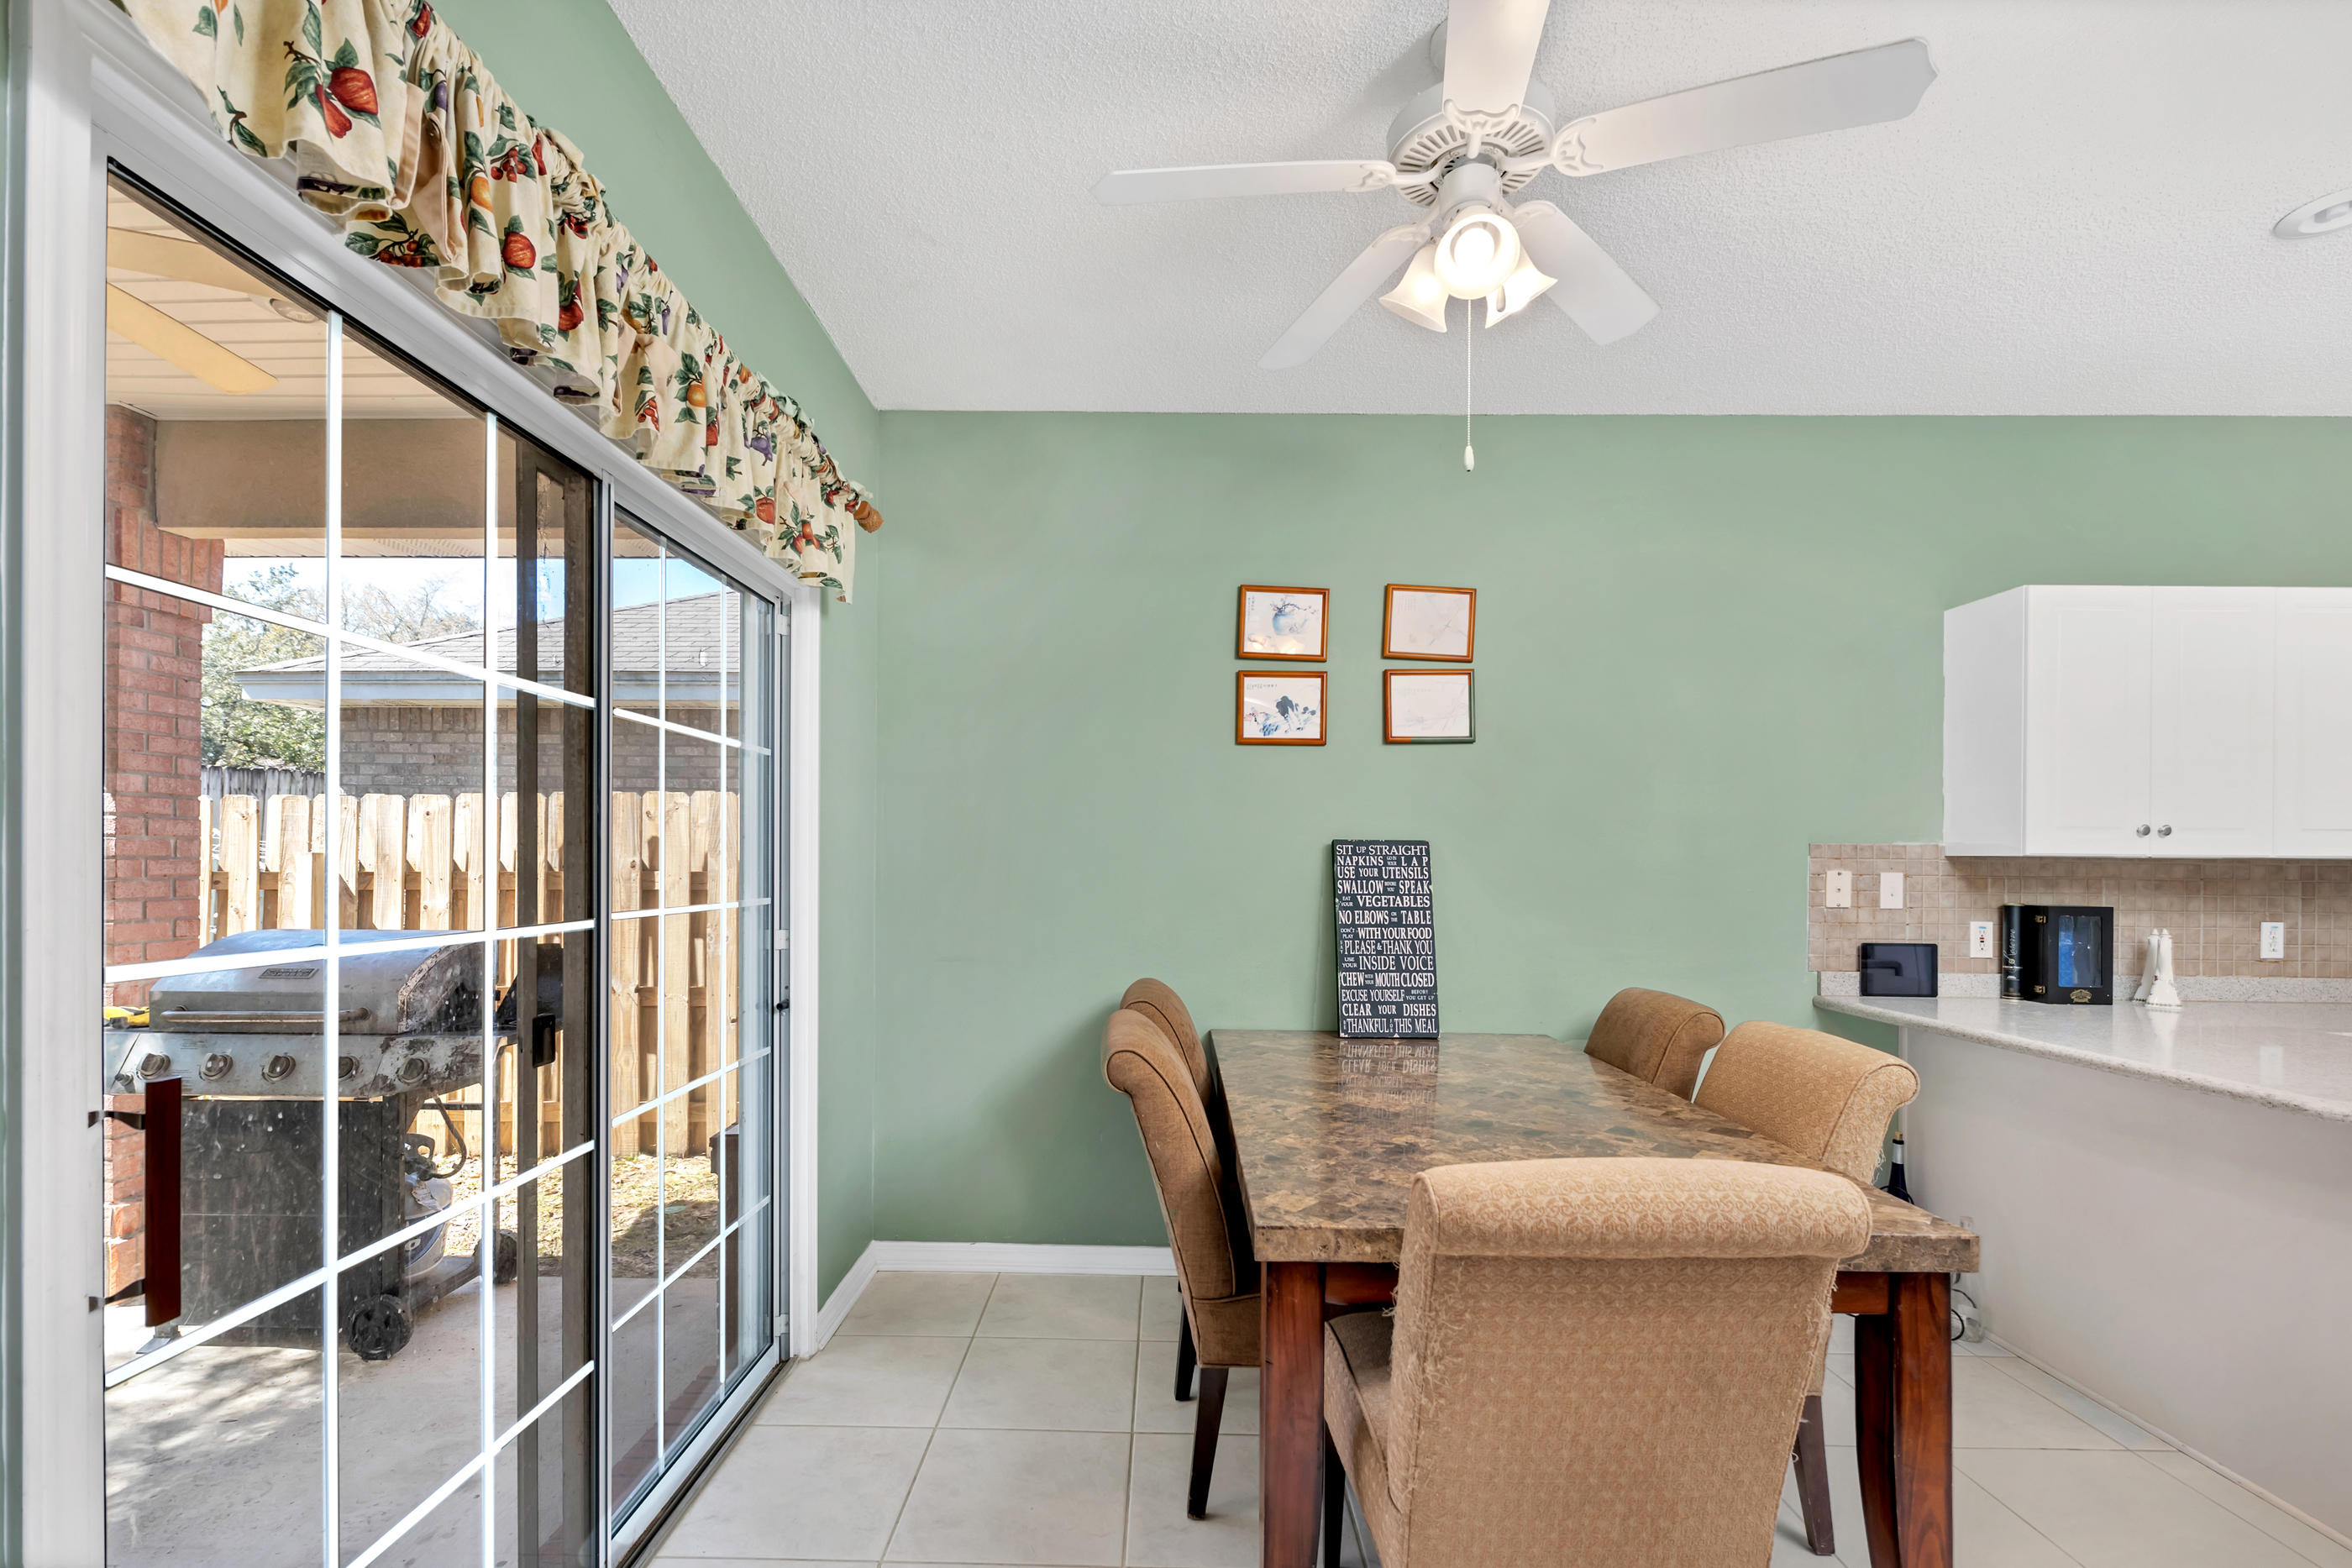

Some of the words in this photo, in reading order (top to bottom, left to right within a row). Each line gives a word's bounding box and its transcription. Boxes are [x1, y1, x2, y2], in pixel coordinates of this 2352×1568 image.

[1336, 845, 1353, 855] SIT
[1369, 845, 1427, 855] STRAIGHT
[1337, 856, 1383, 866] NAPKINS
[1401, 857, 1428, 866] LAP
[1337, 867, 1355, 878] USE
[1359, 868, 1378, 877] YOUR
[1382, 867, 1428, 878] UTENSILS
[1337, 880, 1383, 894] SWALLOW
[1399, 880, 1430, 894] SPEAK
[1357, 895, 1430, 907] VEGETABLES
[1339, 910, 1352, 924] NO
[1355, 910, 1389, 924] ELBOWS
[1401, 910, 1431, 924] TABLE
[1357, 927, 1381, 939] WITH
[1381, 927, 1408, 939] YOUR
[1408, 927, 1431, 939] FOOD
[1345, 941, 1375, 954] PLEASE
[1382, 941, 1413, 954] THANK
[1415, 941, 1432, 954] YOU
[1359, 957, 1395, 970] INSIDE
[1399, 957, 1433, 970] VOICE
[1341, 973, 1364, 986] CHEW
[1375, 973, 1399, 987] MOUTH
[1401, 973, 1434, 987] CLOSED
[1341, 989, 1368, 1001] EXCUSE
[1370, 989, 1404, 1001] YOURSELF
[1342, 1004, 1372, 1016] CLEAR
[1378, 1005, 1396, 1015] YOUR
[1403, 1004, 1436, 1016] DISHES
[1347, 1019, 1389, 1033] THANKFUL
[1394, 1019, 1411, 1033] THIS
[1415, 1019, 1437, 1033] MEAL
